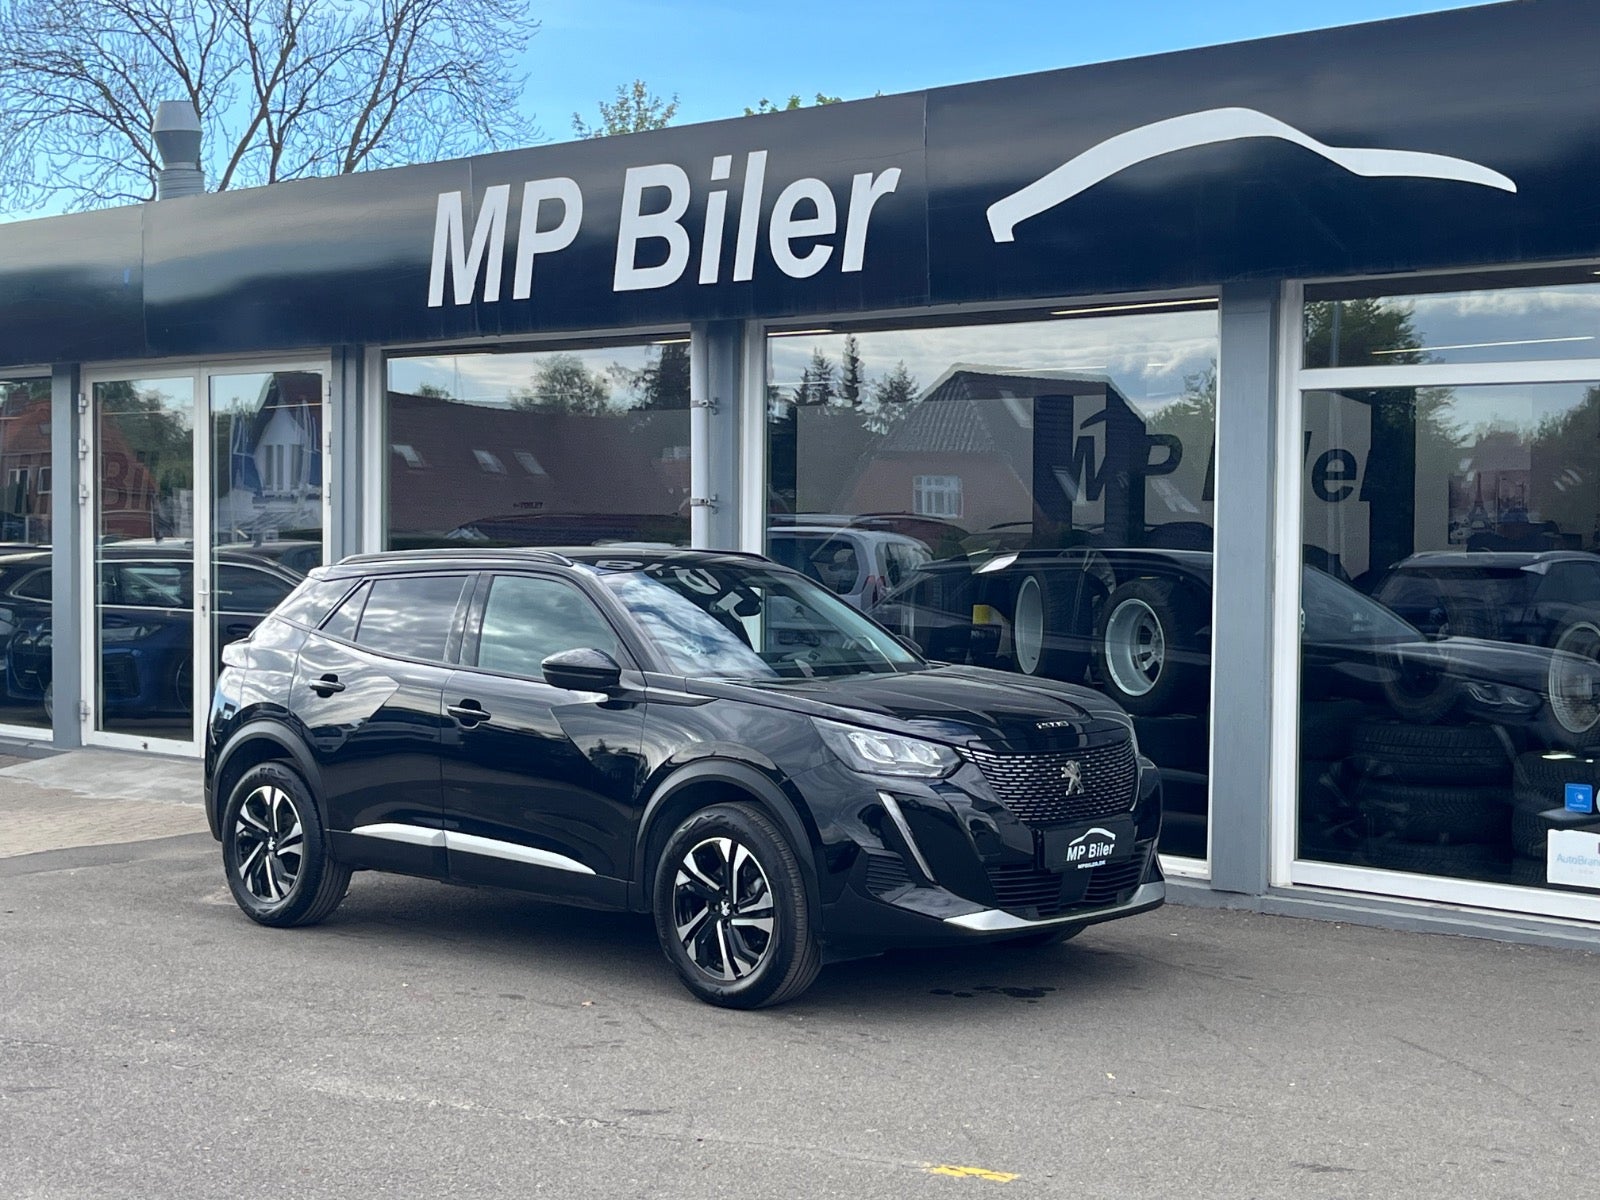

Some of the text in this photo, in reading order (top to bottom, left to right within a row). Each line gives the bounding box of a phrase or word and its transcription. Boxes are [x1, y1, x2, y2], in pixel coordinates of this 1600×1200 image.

[428, 150, 901, 307] MP Biler
[1066, 842, 1115, 861] MP Biler
